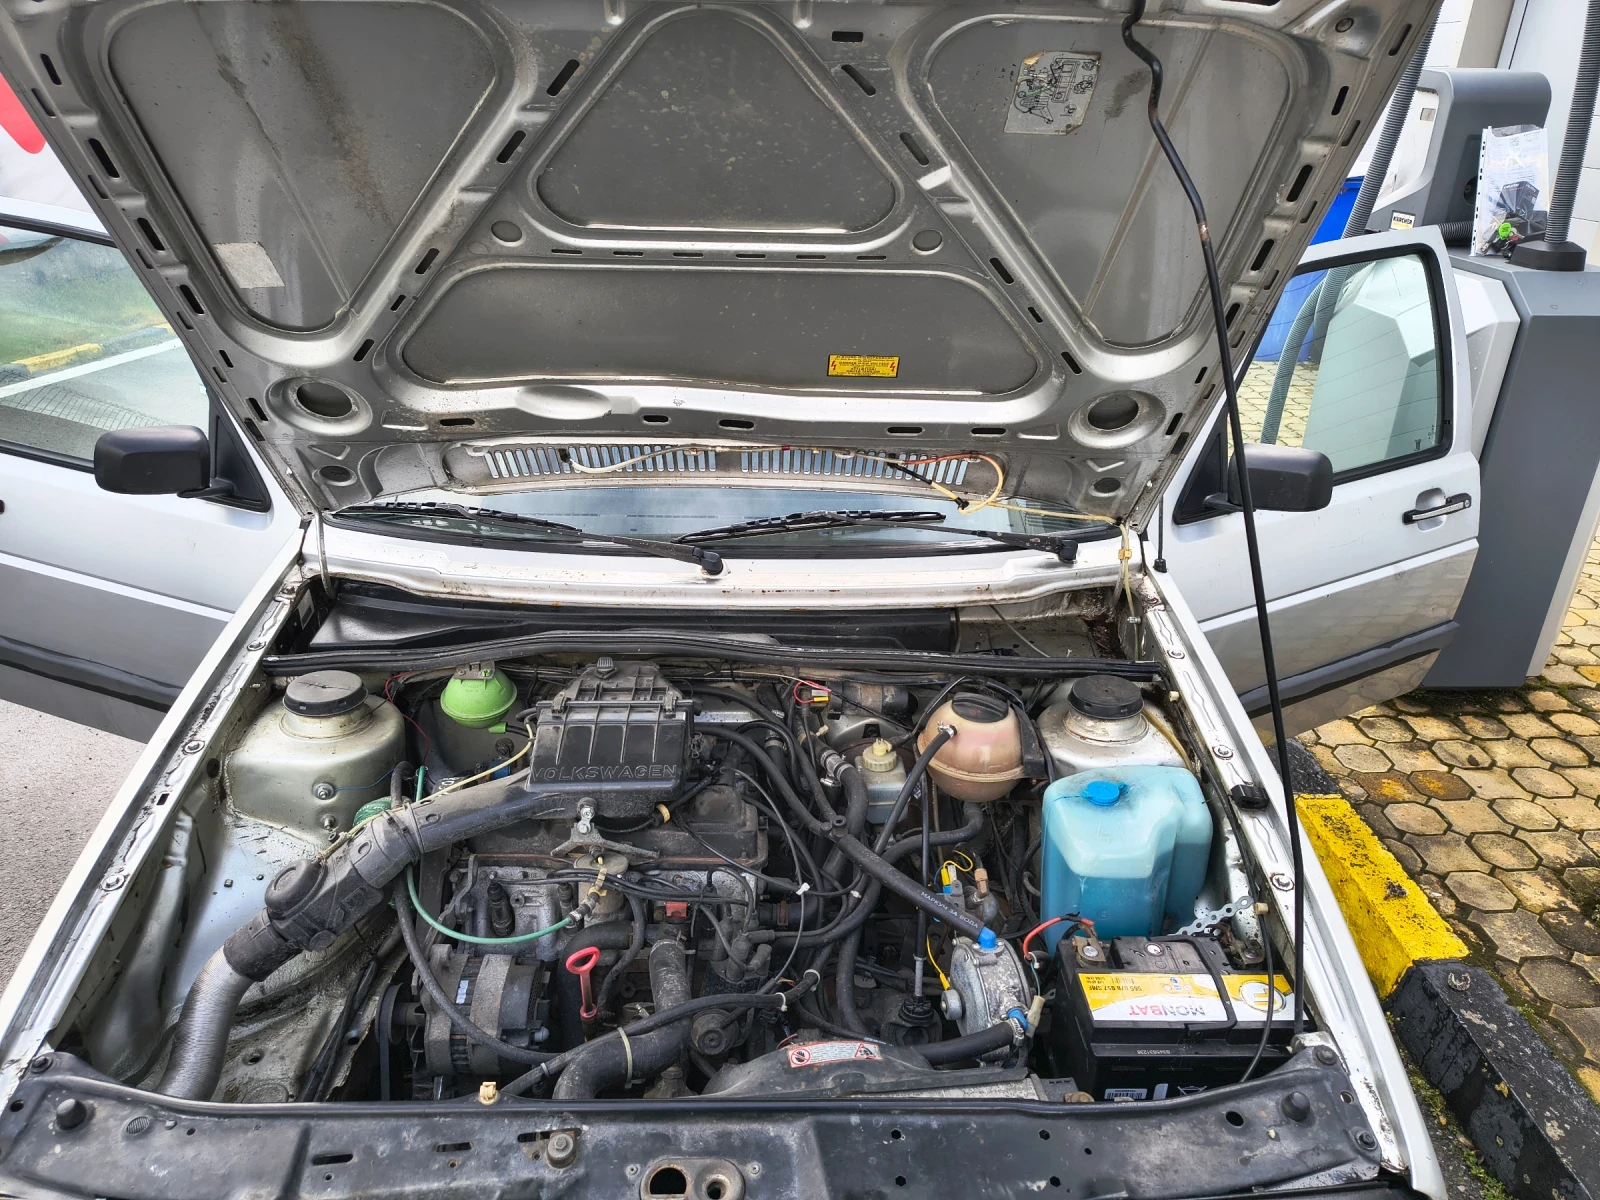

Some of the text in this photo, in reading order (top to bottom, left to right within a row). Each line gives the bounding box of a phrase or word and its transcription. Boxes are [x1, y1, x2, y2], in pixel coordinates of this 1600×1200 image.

[531, 765, 677, 781] VOLKSWAGEN
[921, 891, 948, 910] МАРКУЧ
[960, 915, 979, 928] ВОДА
[1128, 1004, 1206, 1016] MONBAT
